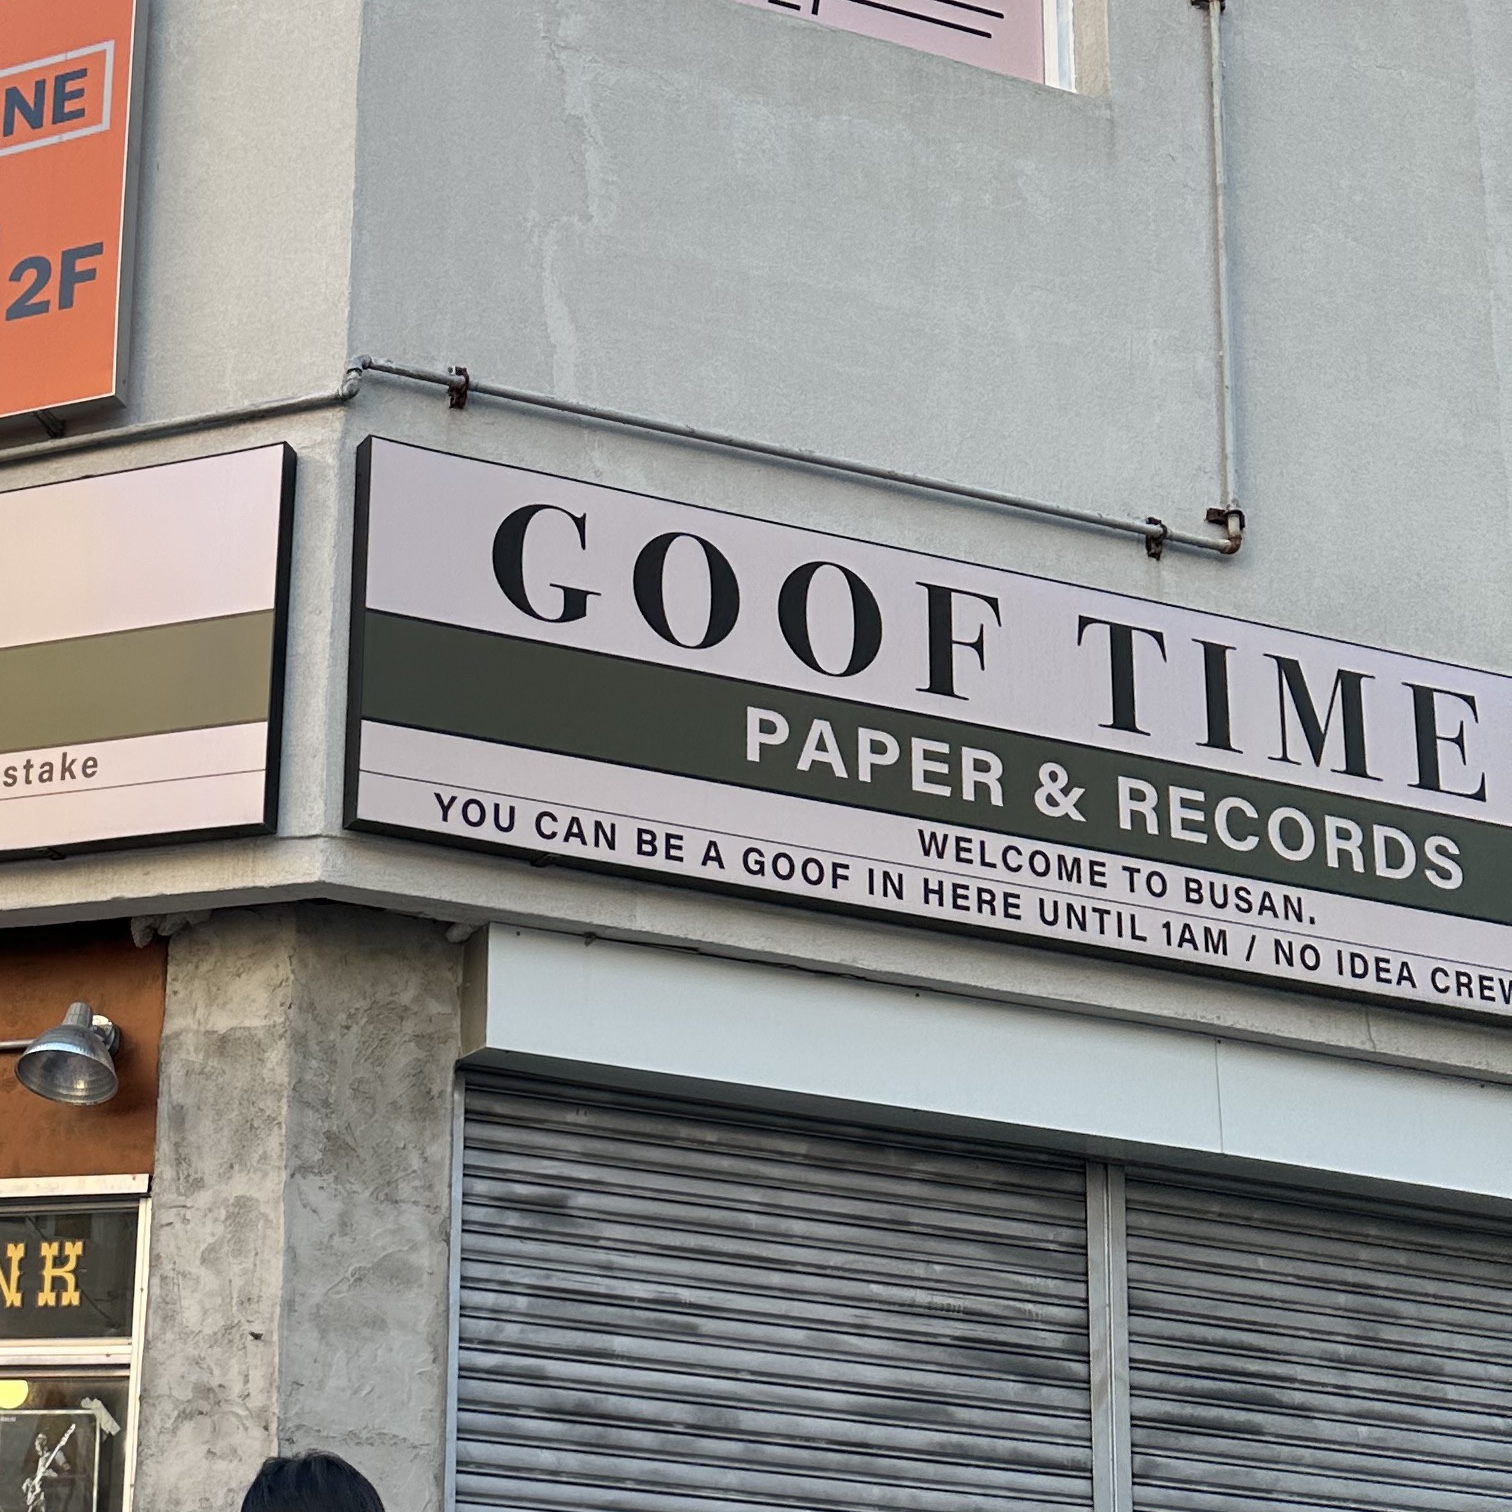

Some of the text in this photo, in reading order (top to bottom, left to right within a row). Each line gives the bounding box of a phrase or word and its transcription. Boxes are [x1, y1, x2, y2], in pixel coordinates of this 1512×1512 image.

[5, 242, 103, 321] 2F
[492, 503, 1487, 803] GOOF TIME
[433, 791, 516, 833] YOU
[535, 811, 616, 851] CAN
[636, 828, 685, 862] BE
[701, 840, 726, 870] A
[742, 847, 850, 890] GOOF
[868, 868, 904, 902] IN
[923, 877, 1022, 921] HERE
[1039, 898, 1147, 943] UNTIL
[1161, 919, 1228, 957] 1AM
[1245, 935, 1256, 962] /
[1274, 939, 1321, 972] NO
[1337, 950, 1417, 990] IDEA
[745, 705, 1465, 891] PAPER & RECORDS
[918, 829, 1317, 925] WELCOME TO BUSAN.
